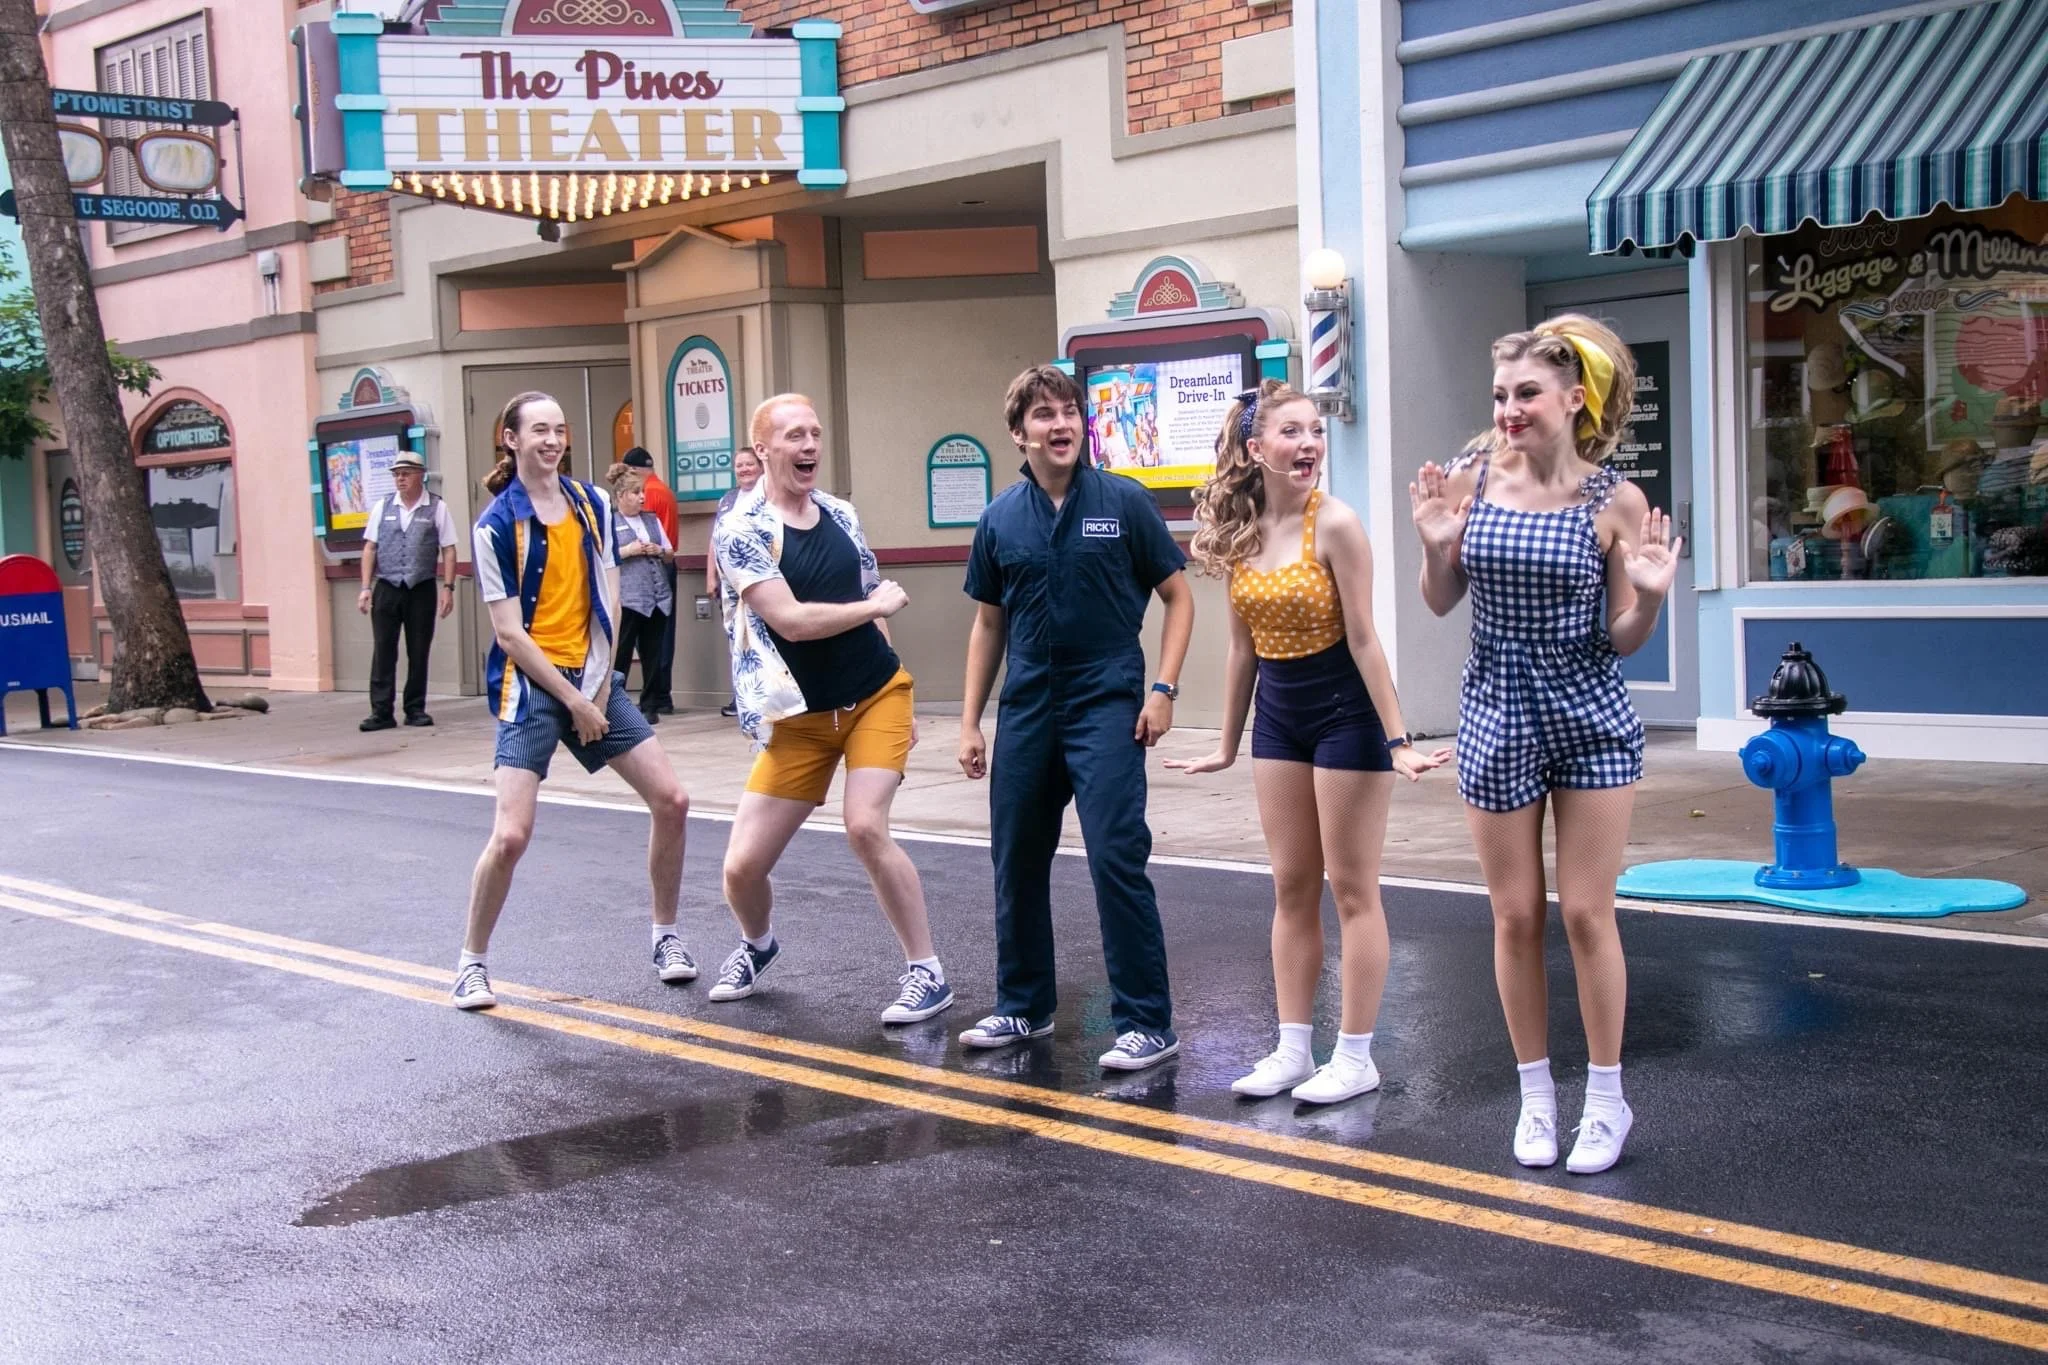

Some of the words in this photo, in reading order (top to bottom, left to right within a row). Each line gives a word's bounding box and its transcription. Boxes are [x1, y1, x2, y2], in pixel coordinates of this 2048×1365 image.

[460, 50, 564, 100] The
[575, 49, 724, 100] Pines
[53, 91, 196, 119] PTOMETRIST
[398, 107, 788, 162] THEATER
[79, 197, 97, 215] U.
[190, 203, 221, 221] O.D.
[1771, 254, 1898, 313] Luggage
[1908, 255, 1926, 274] &
[1894, 289, 1949, 313] SHOP
[677, 377, 725, 397] TICKETS
[1169, 372, 1233, 389] Dreamland
[1177, 389, 1226, 404] Drive-In
[156, 426, 221, 449] OPTOMETRIST
[1085, 522, 1116, 533] RICKY
